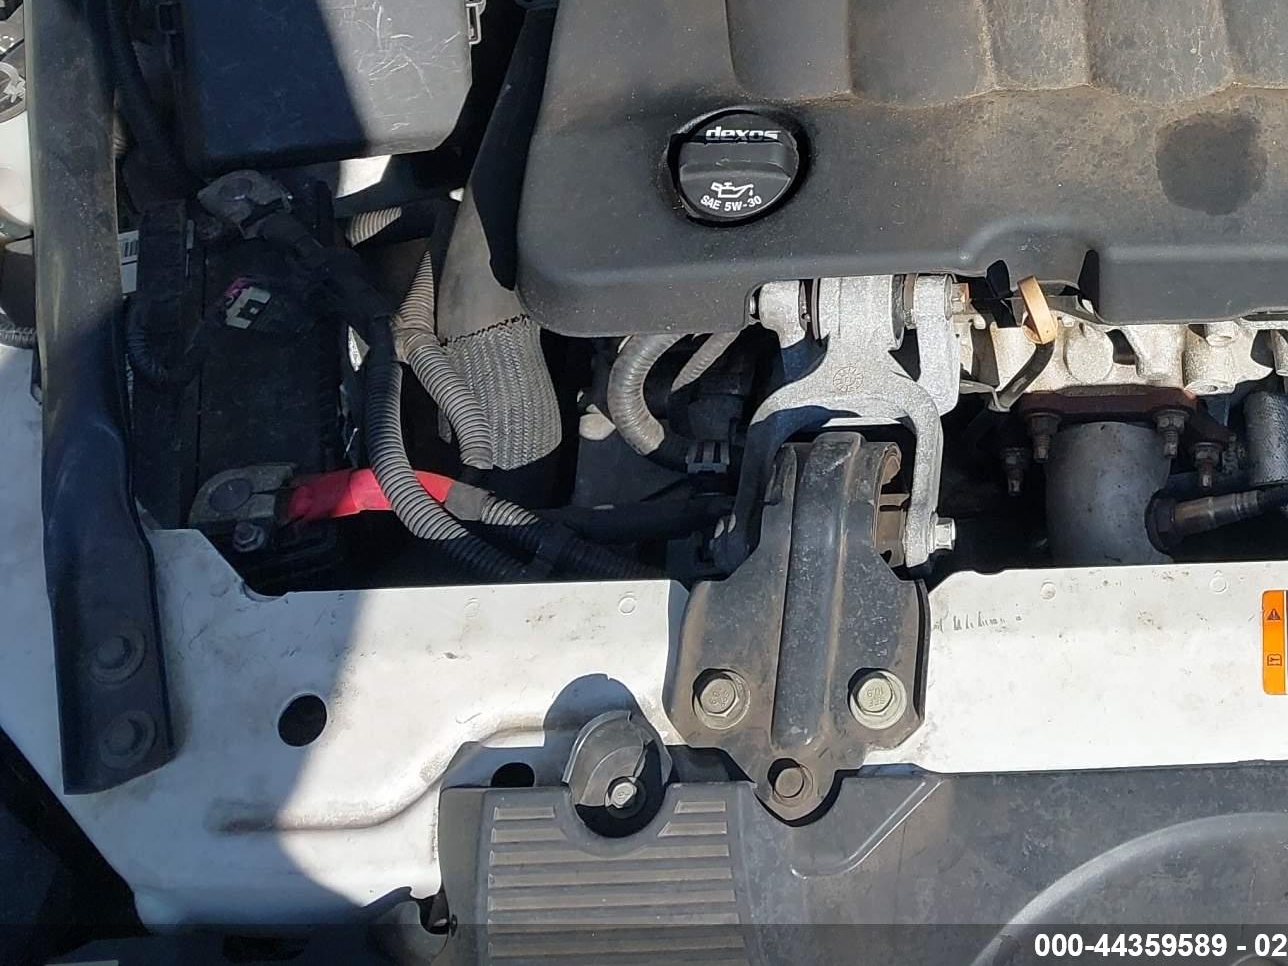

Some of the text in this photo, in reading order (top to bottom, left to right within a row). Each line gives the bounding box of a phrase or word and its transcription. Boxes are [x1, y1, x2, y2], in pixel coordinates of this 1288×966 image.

[705, 125, 782, 142] dexos
[700, 195, 763, 212] SAE 5W-30
